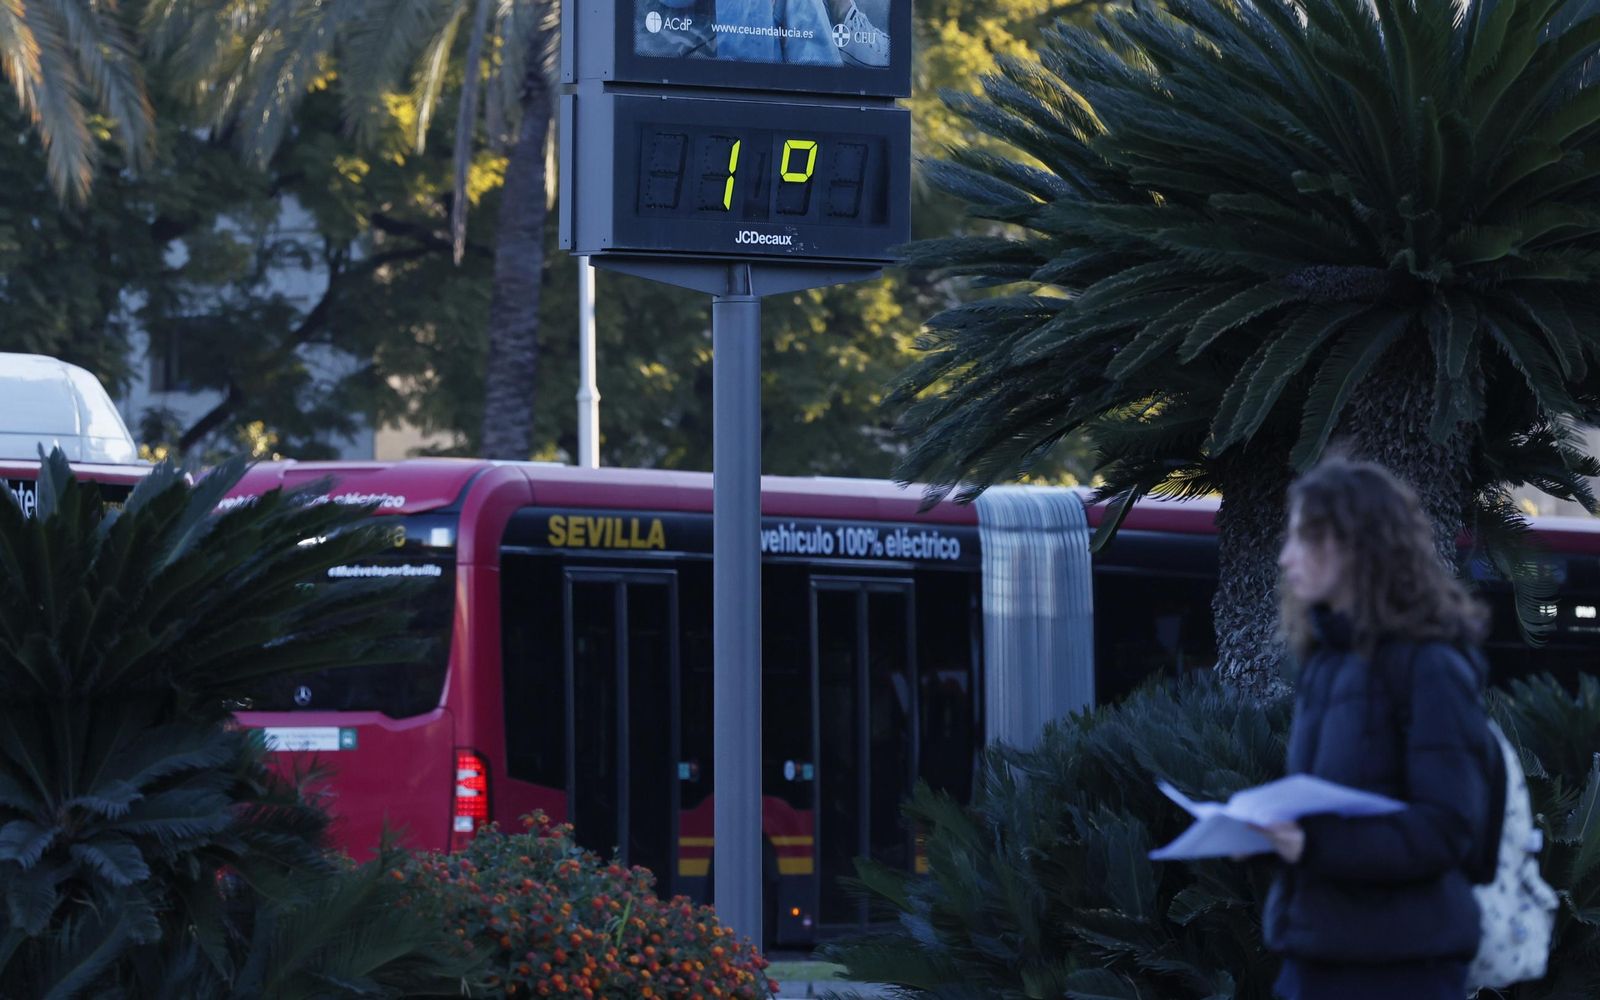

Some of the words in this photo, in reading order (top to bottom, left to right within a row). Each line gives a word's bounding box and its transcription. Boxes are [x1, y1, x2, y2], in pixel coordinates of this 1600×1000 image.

[663, 16, 693, 32] ACdP
[711, 22, 814, 39] www.ceuandalucia.es
[853, 30, 877, 45] CEU
[735, 230, 792, 245] JCDecaux
[547, 514, 666, 550] SEVILLA
[761, 522, 834, 555] vehículo
[835, 526, 884, 557] 100%
[885, 527, 961, 560] eléctrico
